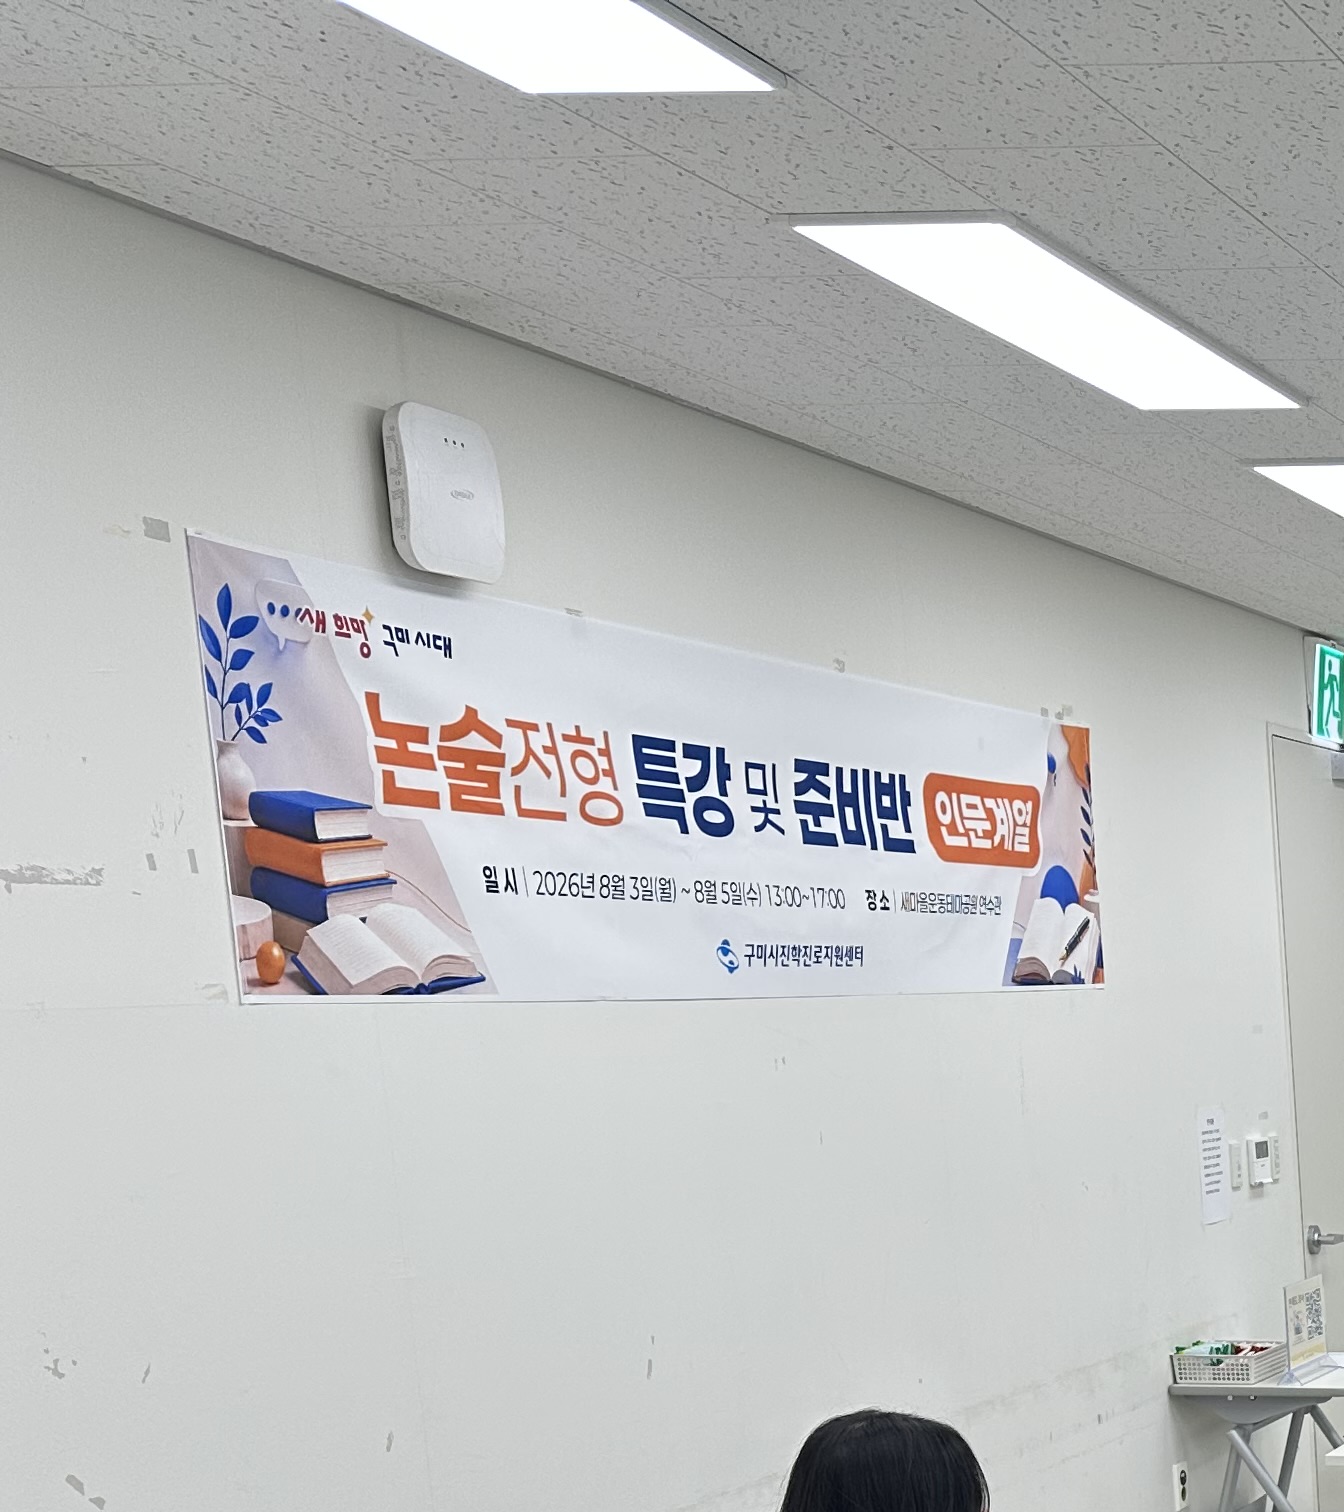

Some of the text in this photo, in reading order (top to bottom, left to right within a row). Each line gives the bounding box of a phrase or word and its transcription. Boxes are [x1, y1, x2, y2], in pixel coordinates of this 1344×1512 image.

[300, 607, 452, 659] 새 희망 구미 시대
[364, 691, 1032, 854] 논술전형 특강 및 준비반 인문계열
[533, 870, 595, 899] 2026년
[600, 874, 626, 900] 8월
[629, 876, 677, 903] 3일(월)
[694, 880, 718, 905] 8월
[721, 881, 762, 907] 5일(수)
[744, 943, 864, 967] 구미시진학진로지원센터
